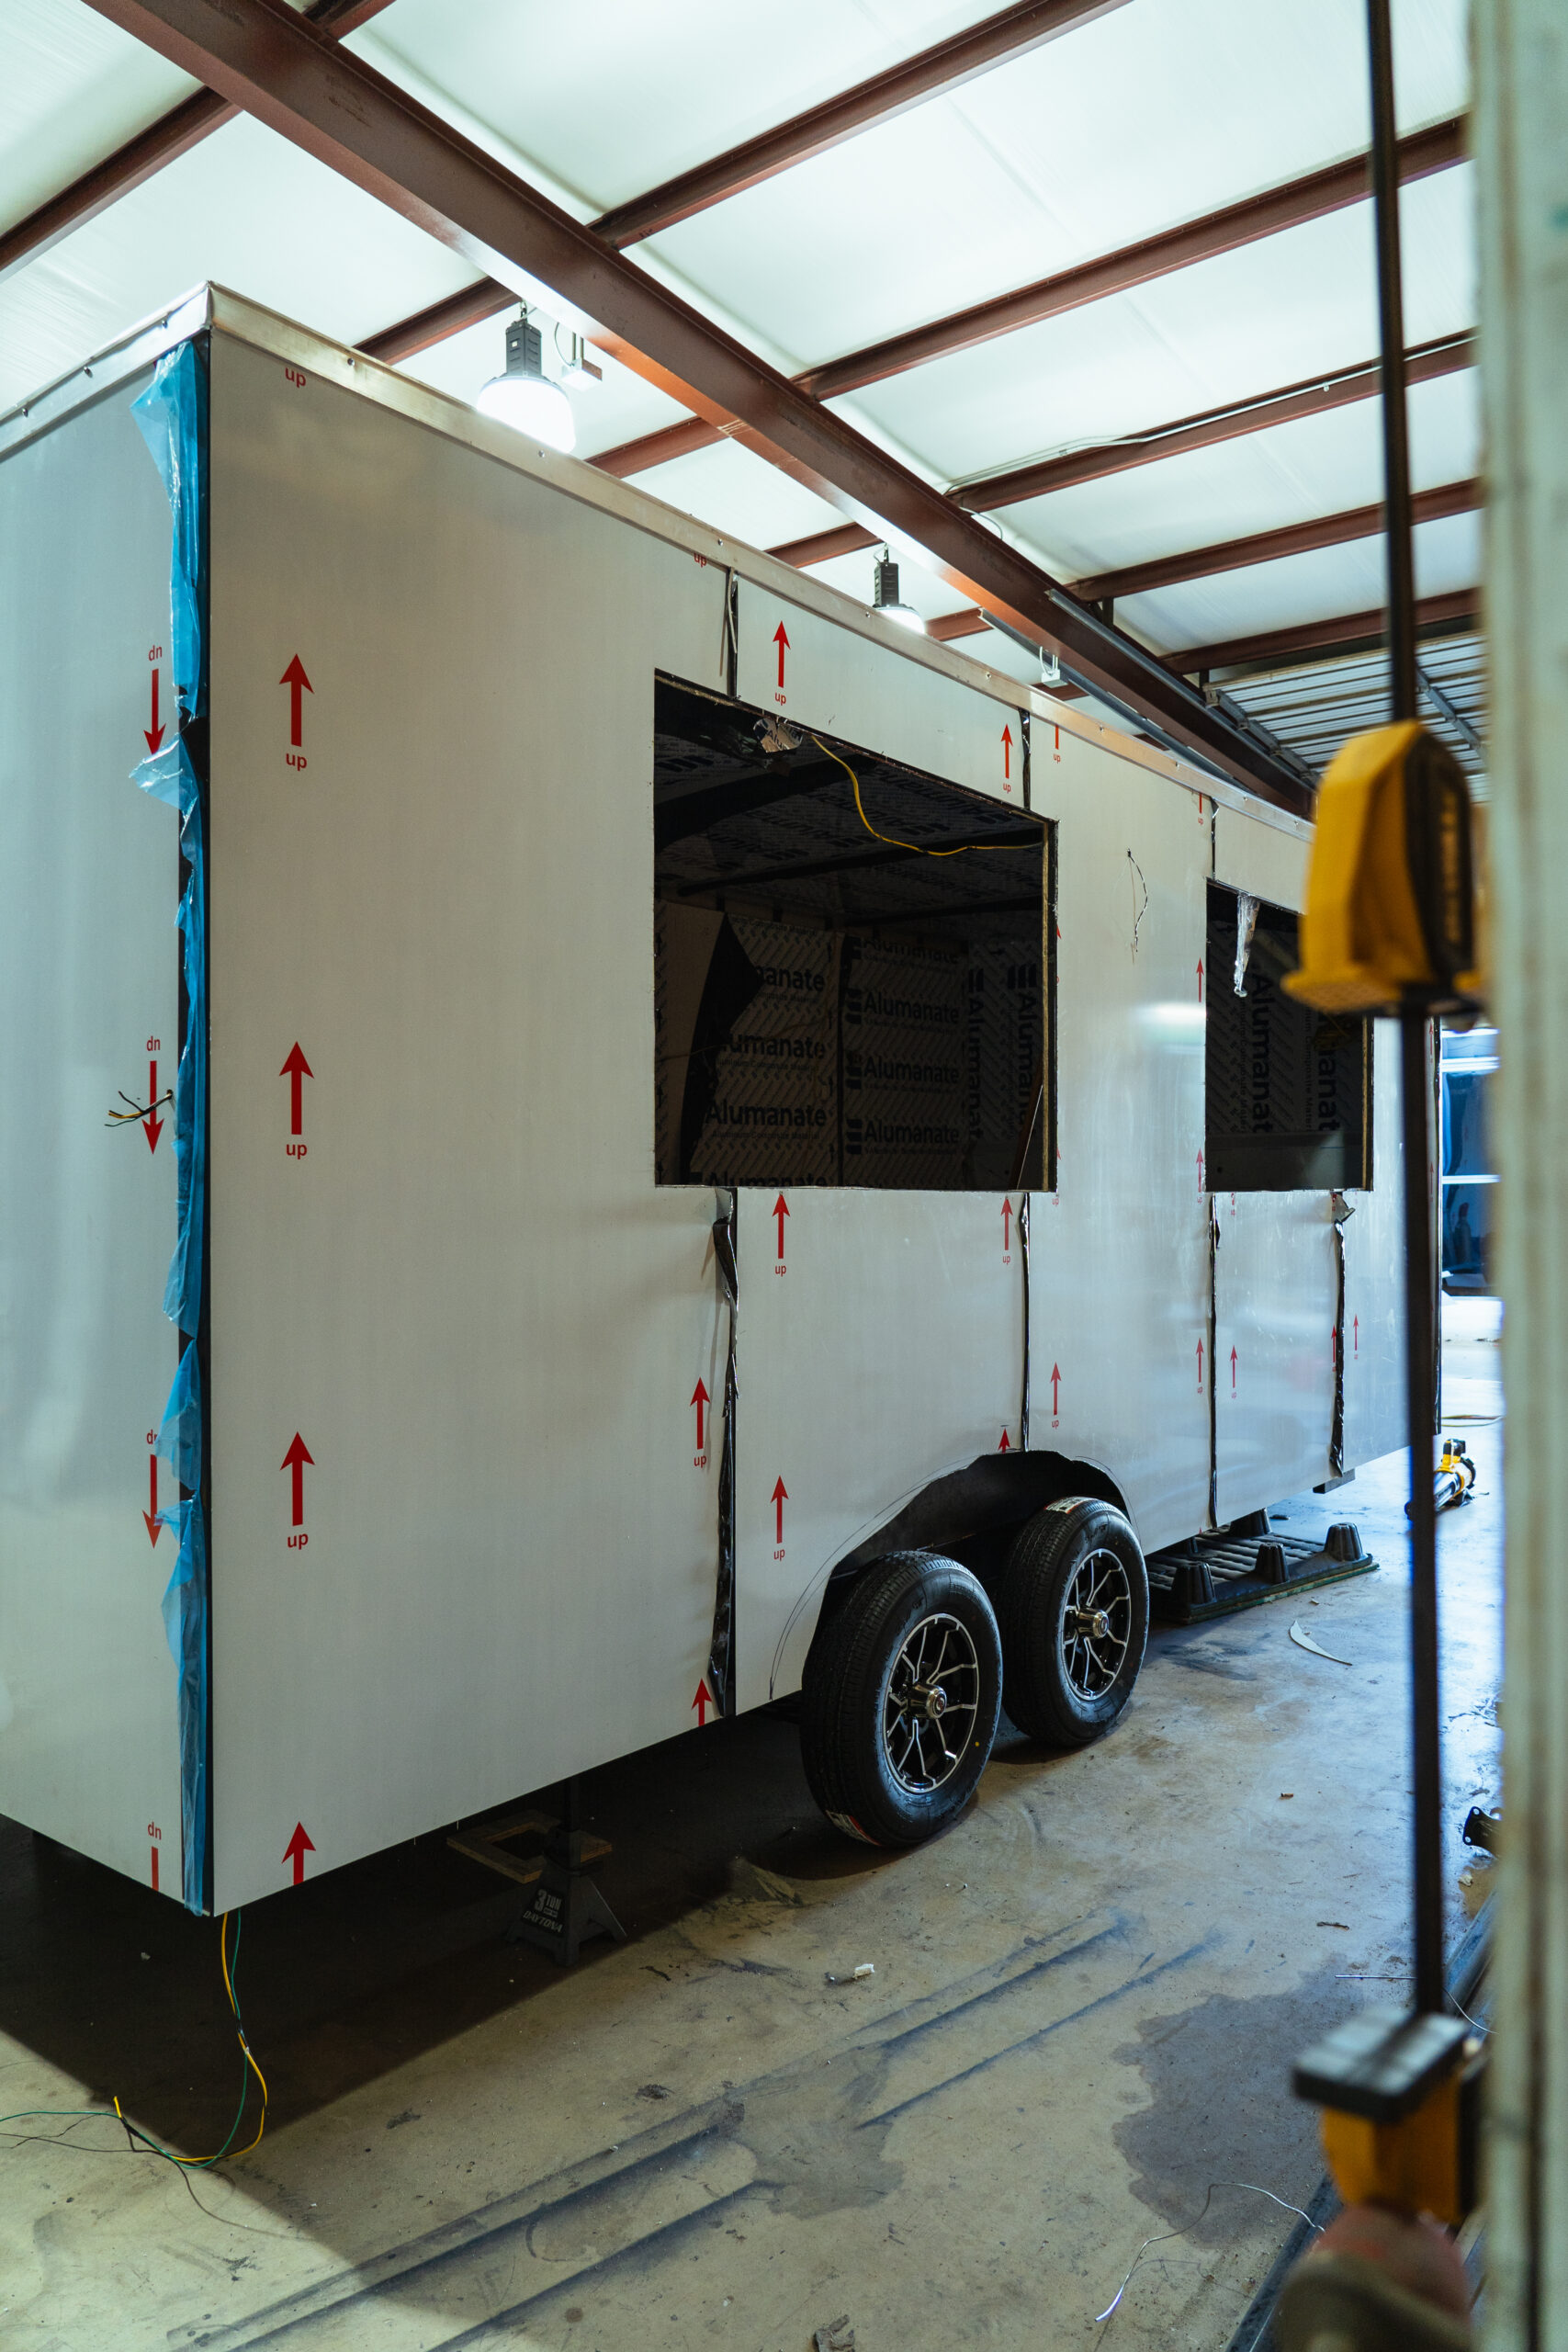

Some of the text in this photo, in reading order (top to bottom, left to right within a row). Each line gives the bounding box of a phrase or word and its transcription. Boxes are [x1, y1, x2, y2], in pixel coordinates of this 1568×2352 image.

[285, 368, 306, 388] up
[694, 552, 707, 568] up
[148, 645, 162, 662] dn
[775, 692, 786, 705] up
[287, 754, 307, 771] up
[1054, 753, 1061, 763] up
[1003, 783, 1011, 794] up
[755, 965, 825, 992] anate
[863, 991, 960, 1024] Alumanate
[147, 1036, 160, 1051] dn
[863, 1055, 960, 1084] Alumanate
[705, 1099, 827, 1127] Alumanate
[864, 1120, 960, 1145] Alumanate
[287, 1145, 307, 1159] up
[1002, 1255, 1010, 1265] up
[775, 1265, 786, 1276] up
[694, 1455, 706, 1468] up
[288, 1534, 308, 1550] up
[773, 1549, 785, 1560] up
[147, 1823, 162, 1839] dn
[535, 1889, 547, 1912] 3
[523, 1910, 563, 1933] DAYTONA
